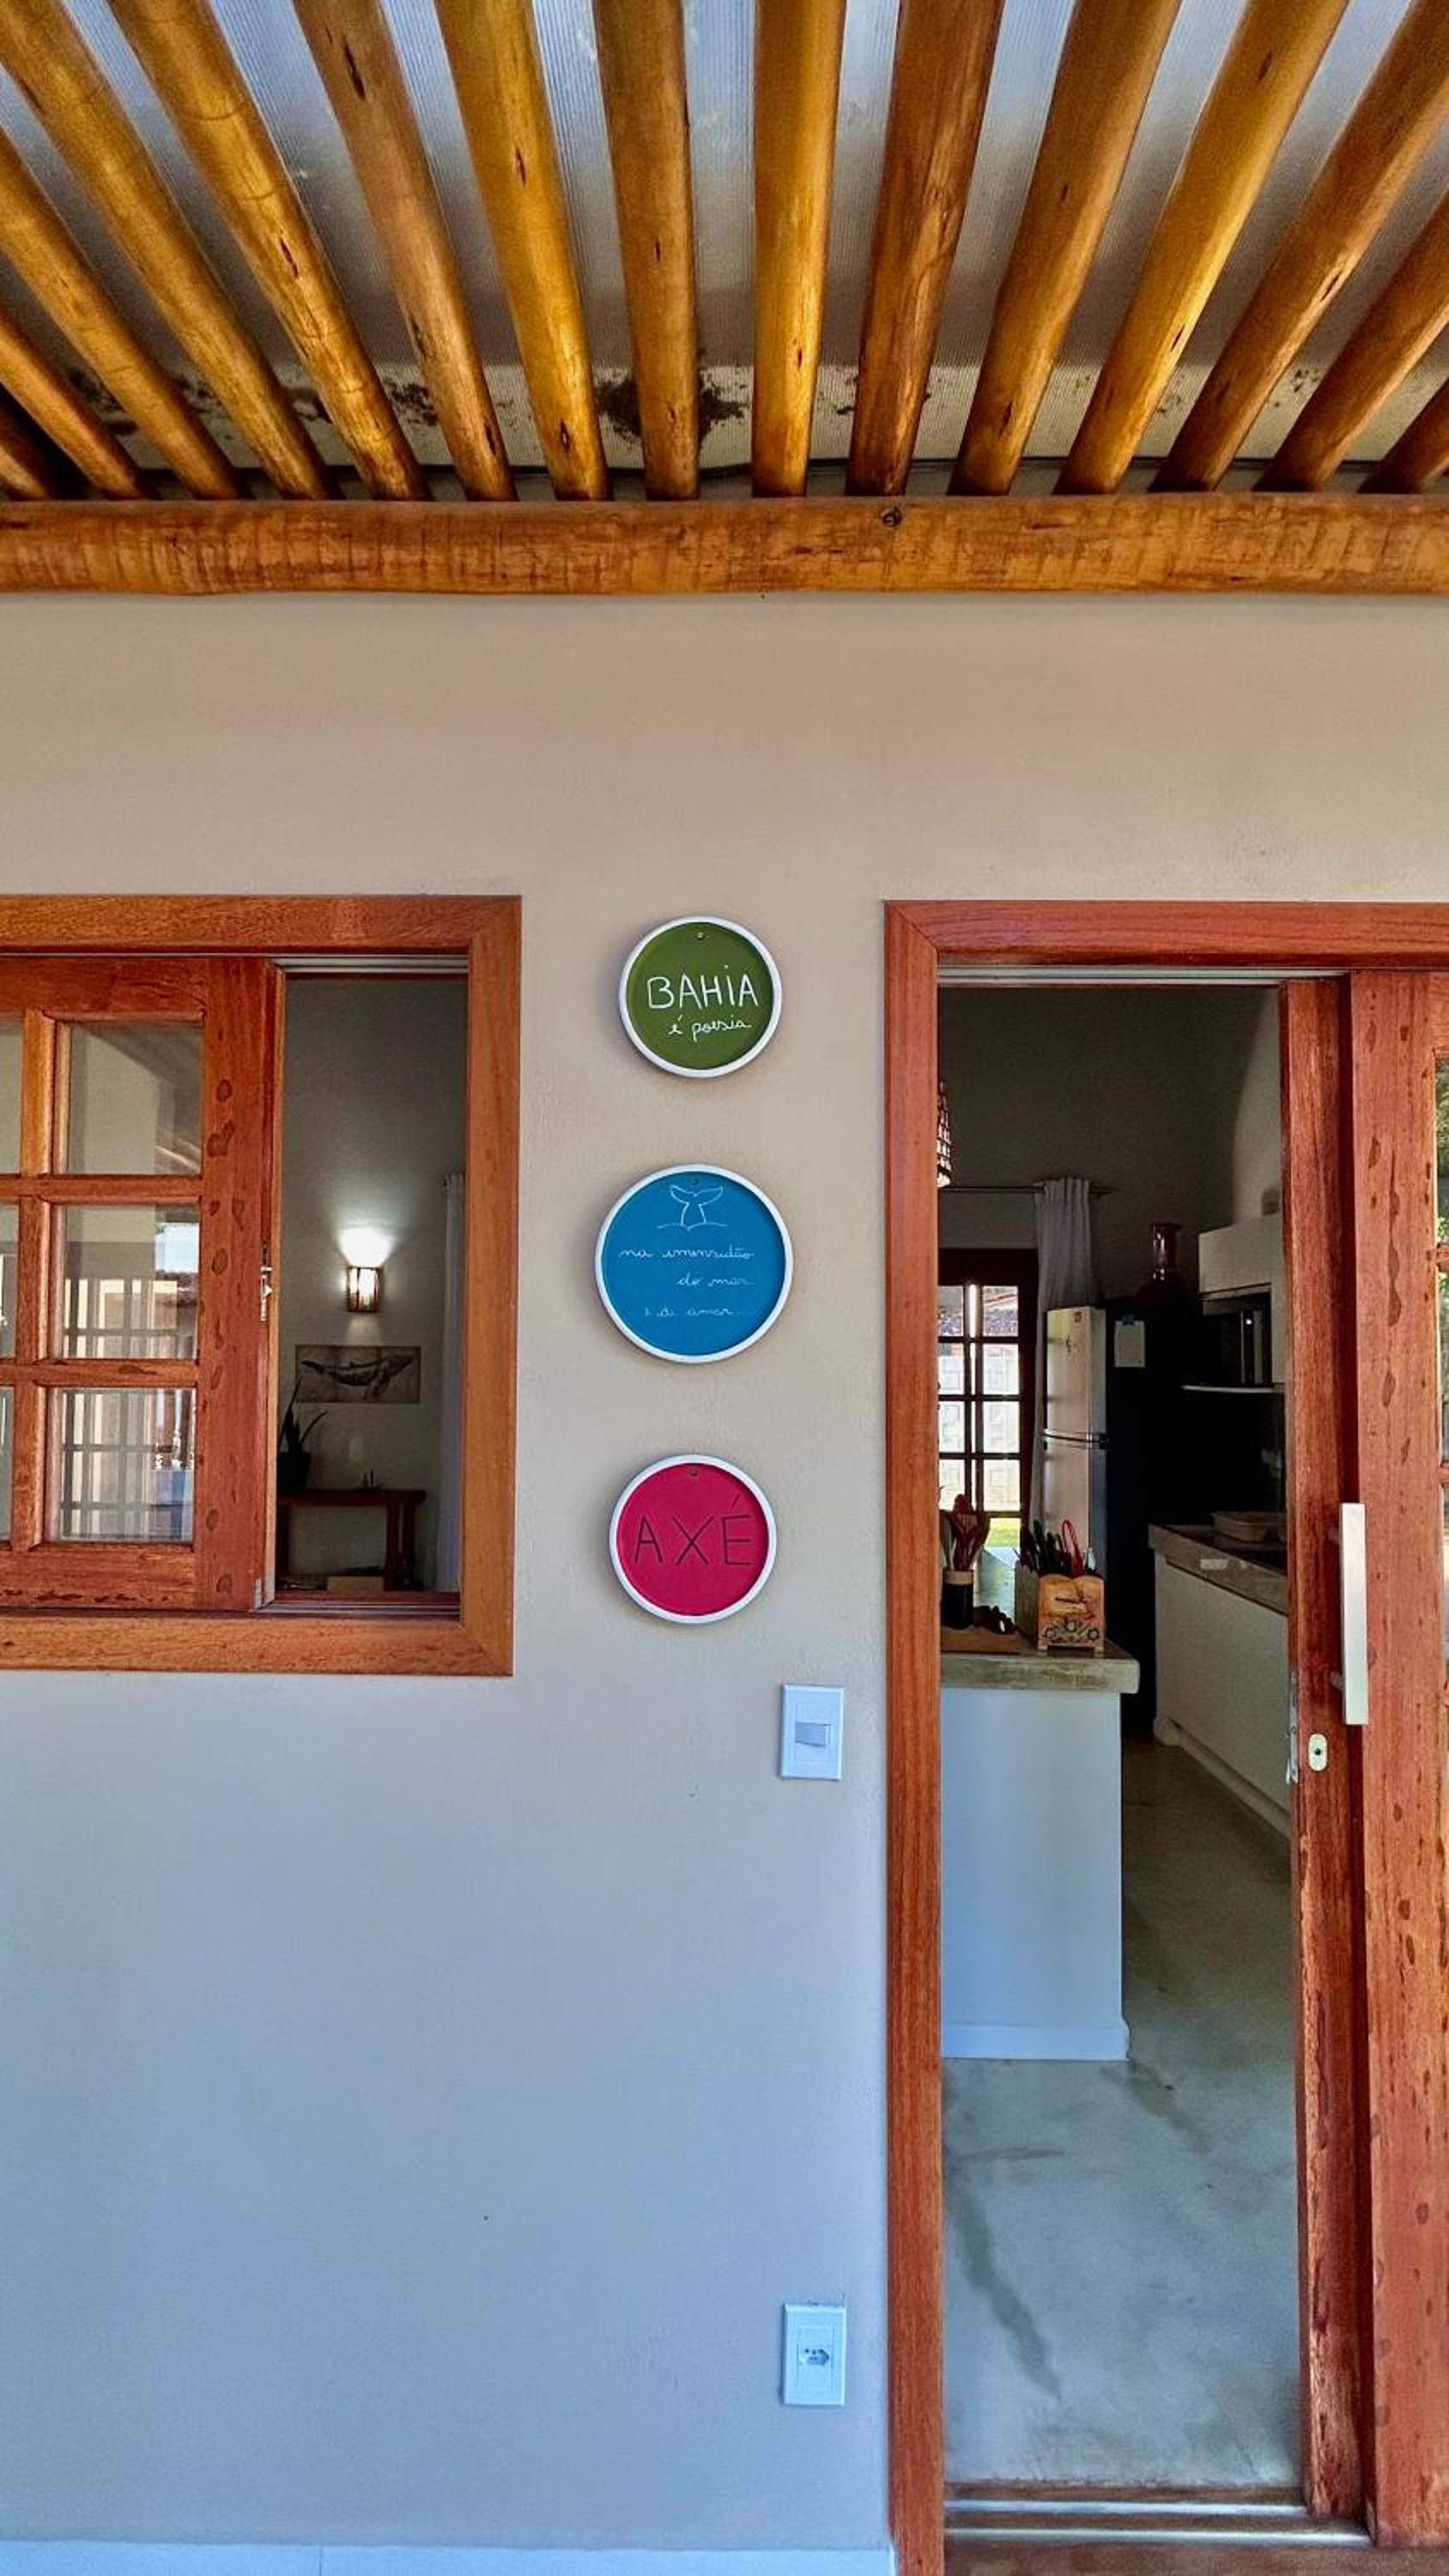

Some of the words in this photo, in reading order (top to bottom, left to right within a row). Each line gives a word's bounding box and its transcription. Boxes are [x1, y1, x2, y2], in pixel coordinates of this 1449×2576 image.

[667, 1014, 683, 1036] é
[691, 1014, 753, 1042] poesia
[618, 1249, 654, 1259] na
[676, 1273, 703, 1286] do
[707, 1277, 755, 1287] mar
[634, 1494, 752, 1566] AXÉ
